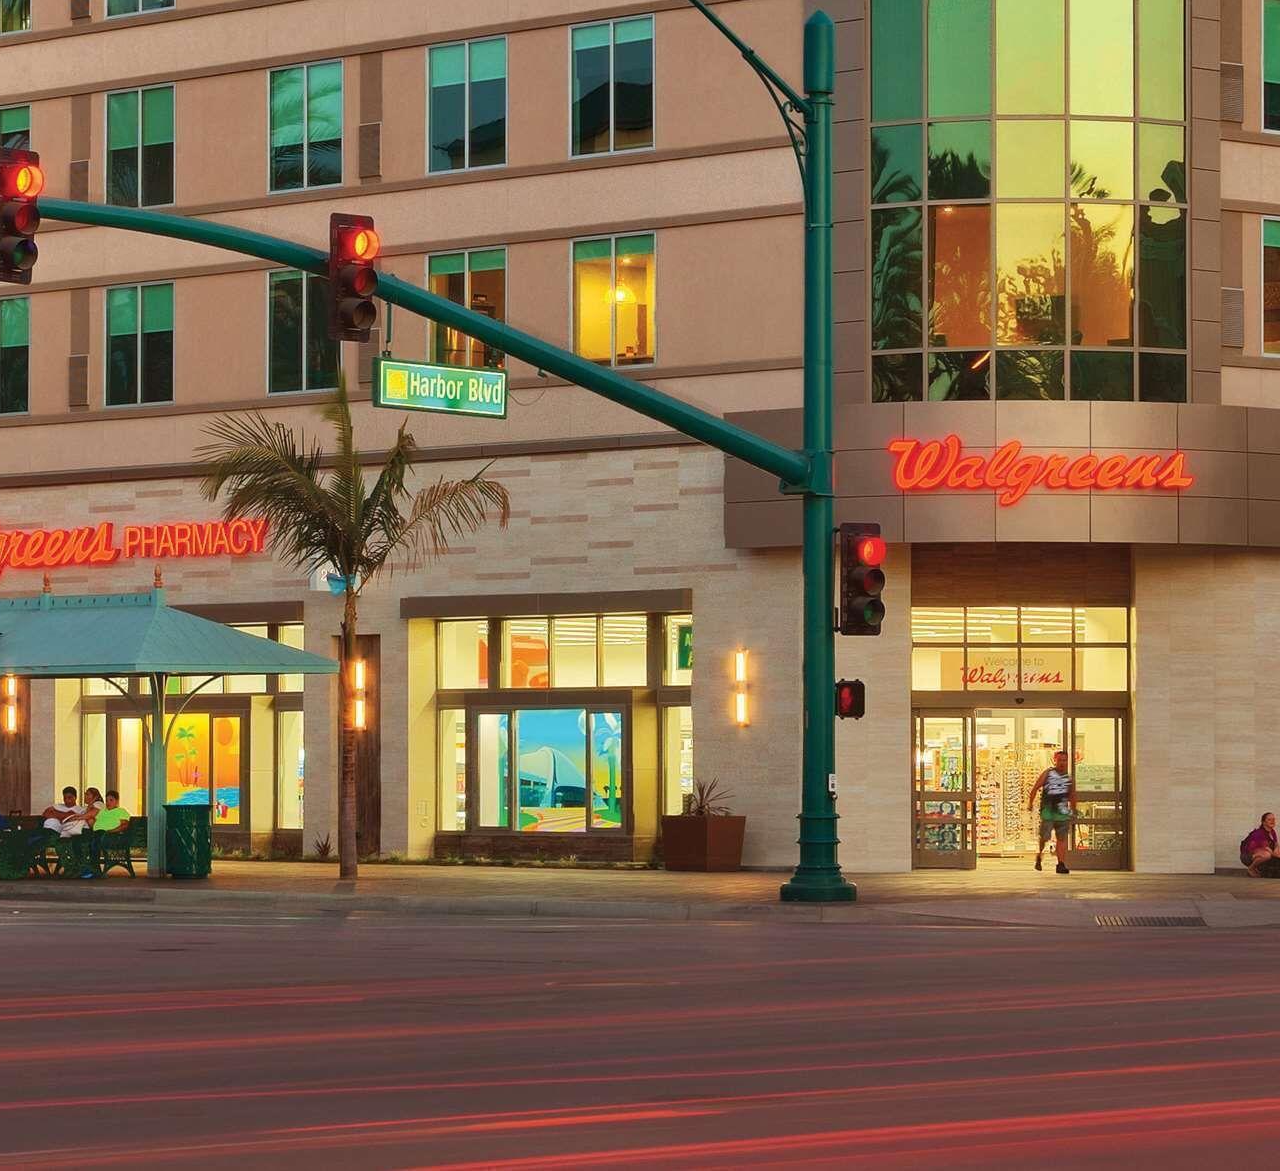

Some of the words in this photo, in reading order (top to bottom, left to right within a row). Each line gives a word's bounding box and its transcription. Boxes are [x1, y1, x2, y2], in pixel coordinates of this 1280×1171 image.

[410, 372, 464, 401] Harbor
[468, 377, 502, 405] Blvd
[888, 433, 1194, 506] Walgreens
[123, 519, 267, 558] PHARMACY
[983, 656, 1032, 667] Welcoe
[1033, 657, 1045, 667] to
